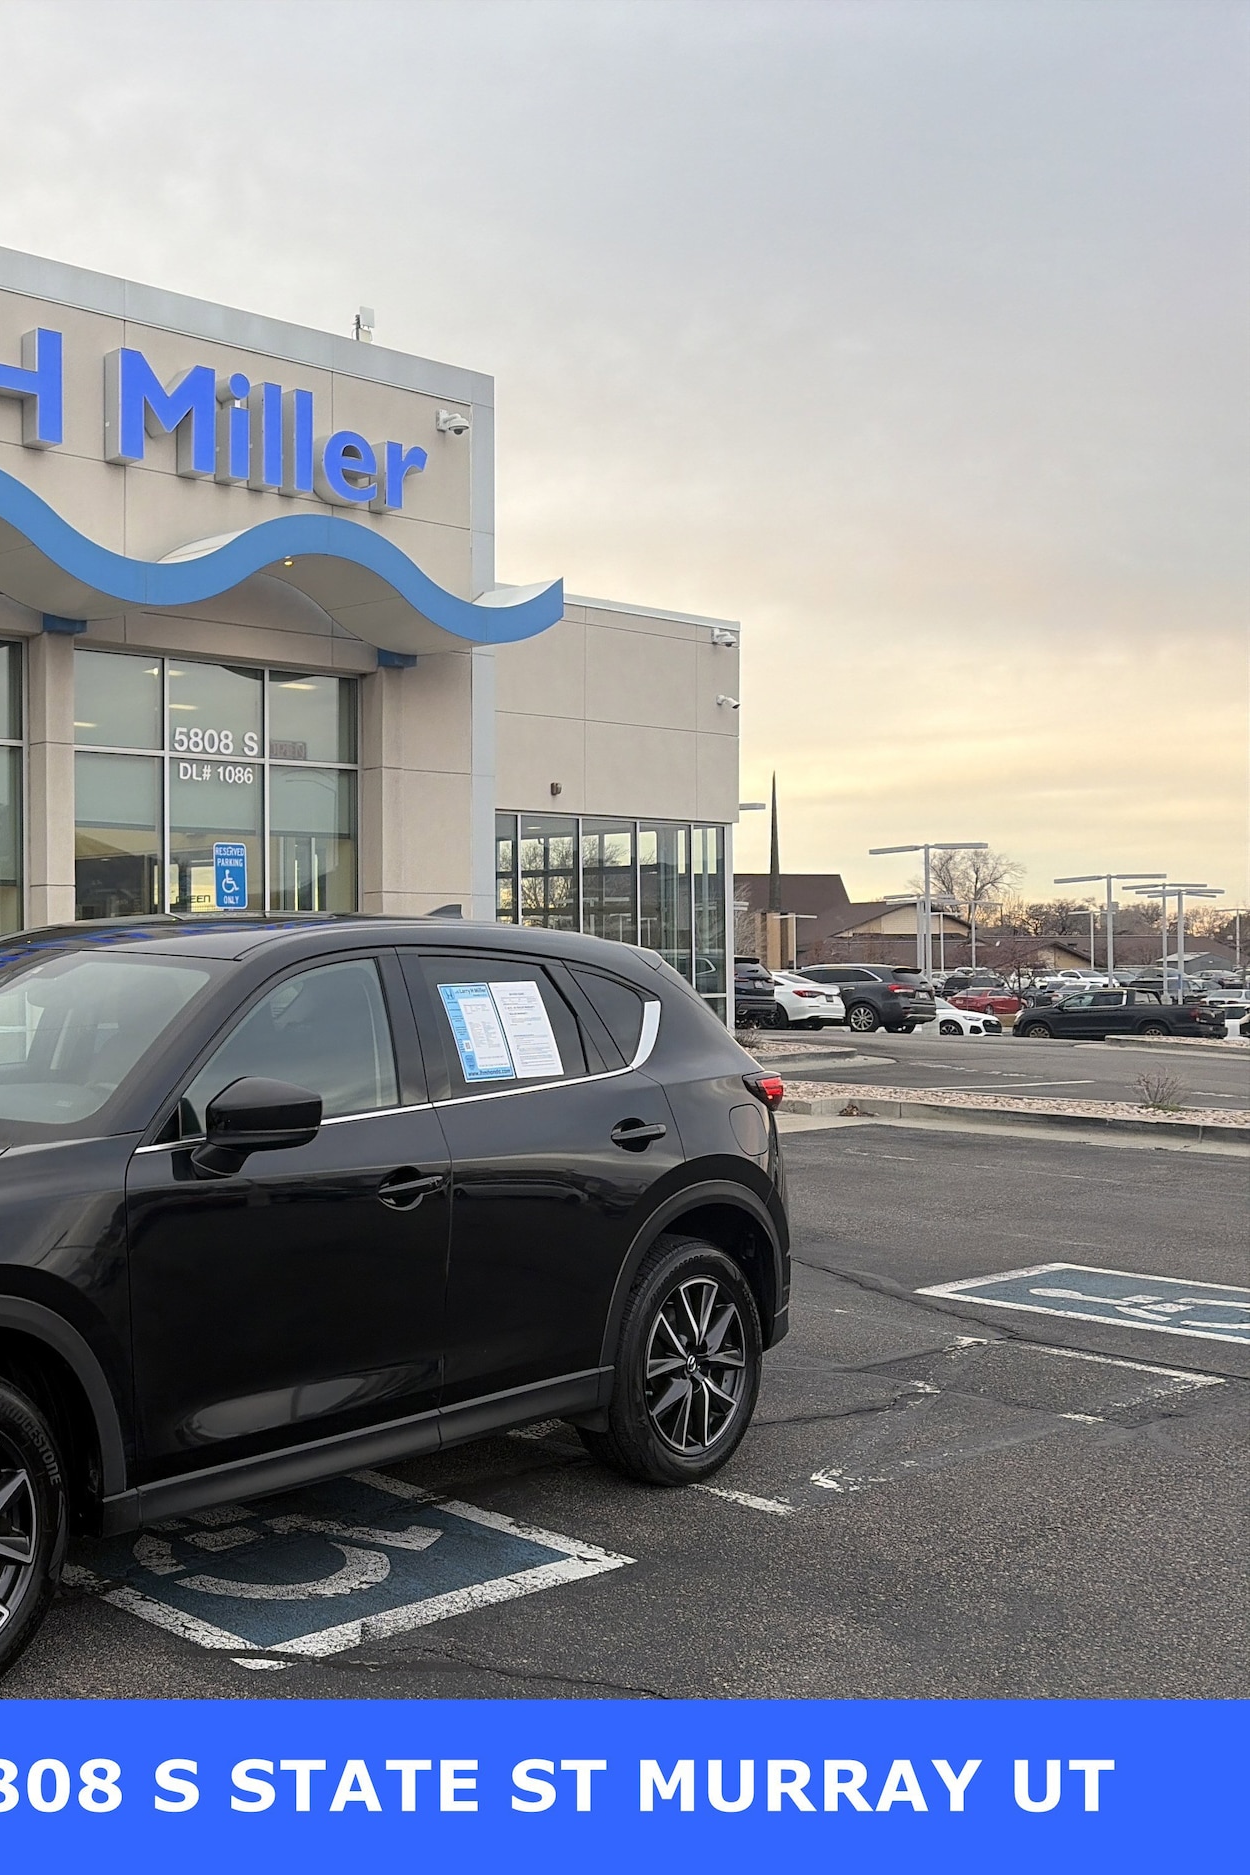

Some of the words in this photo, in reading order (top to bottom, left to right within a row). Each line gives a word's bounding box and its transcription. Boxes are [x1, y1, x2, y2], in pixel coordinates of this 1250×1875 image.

[107, 350, 426, 509] Miller
[173, 726, 234, 755] 5808
[243, 731, 259, 757] S
[178, 762, 212, 781] DL#
[217, 765, 254, 784] 1086
[215, 846, 244, 857] RESERVED
[217, 857, 243, 868] PARKING
[223, 895, 240, 905] ONLY
